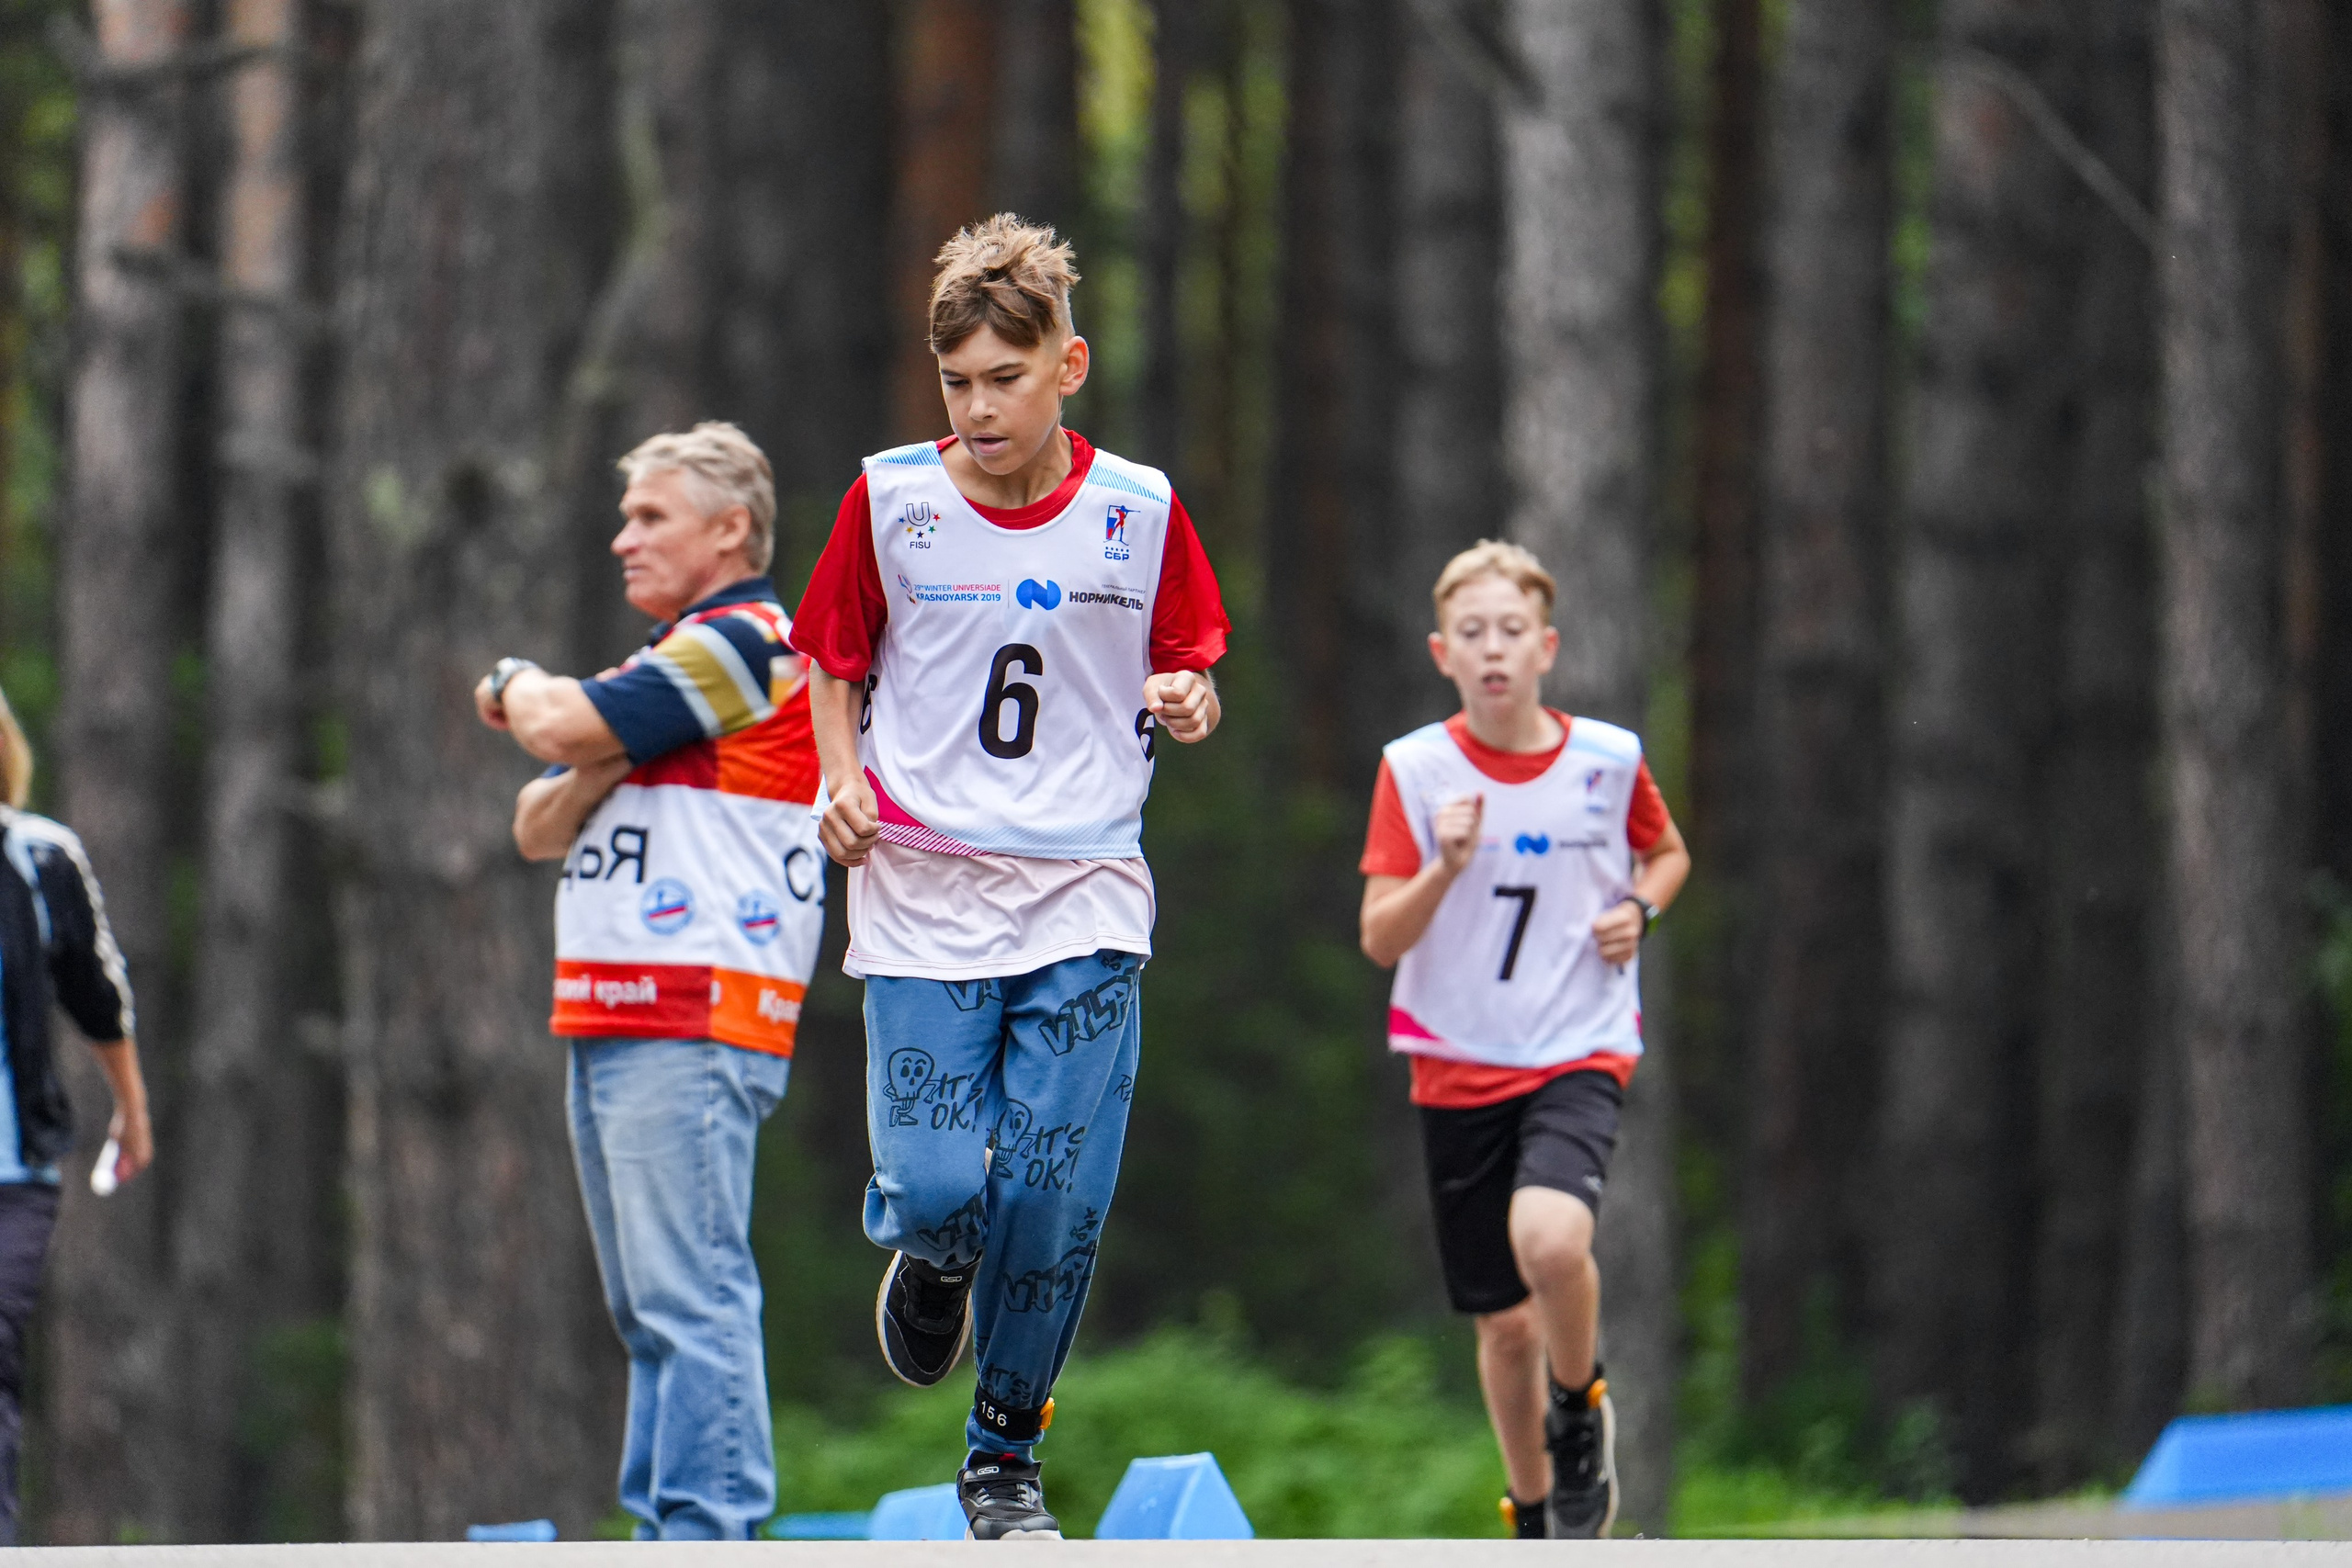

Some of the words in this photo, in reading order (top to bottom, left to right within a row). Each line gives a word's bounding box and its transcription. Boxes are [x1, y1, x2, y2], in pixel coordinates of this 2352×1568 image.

[910, 540, 931, 549] FISU
[1104, 551, 1130, 561] СБР
[915, 592, 979, 602] KRASNOYARSK
[980, 593, 1001, 602] 2019
[952, 583, 1001, 592] UNIVERSIADE
[1069, 591, 1144, 611] НОРНИКЕЛЬ
[978, 642, 1044, 760] 6
[1494, 886, 1536, 980] 7
[930, 1096, 983, 1134] OK!
[1024, 1146, 1080, 1193] OK!
[981, 1400, 1008, 1427] 156
